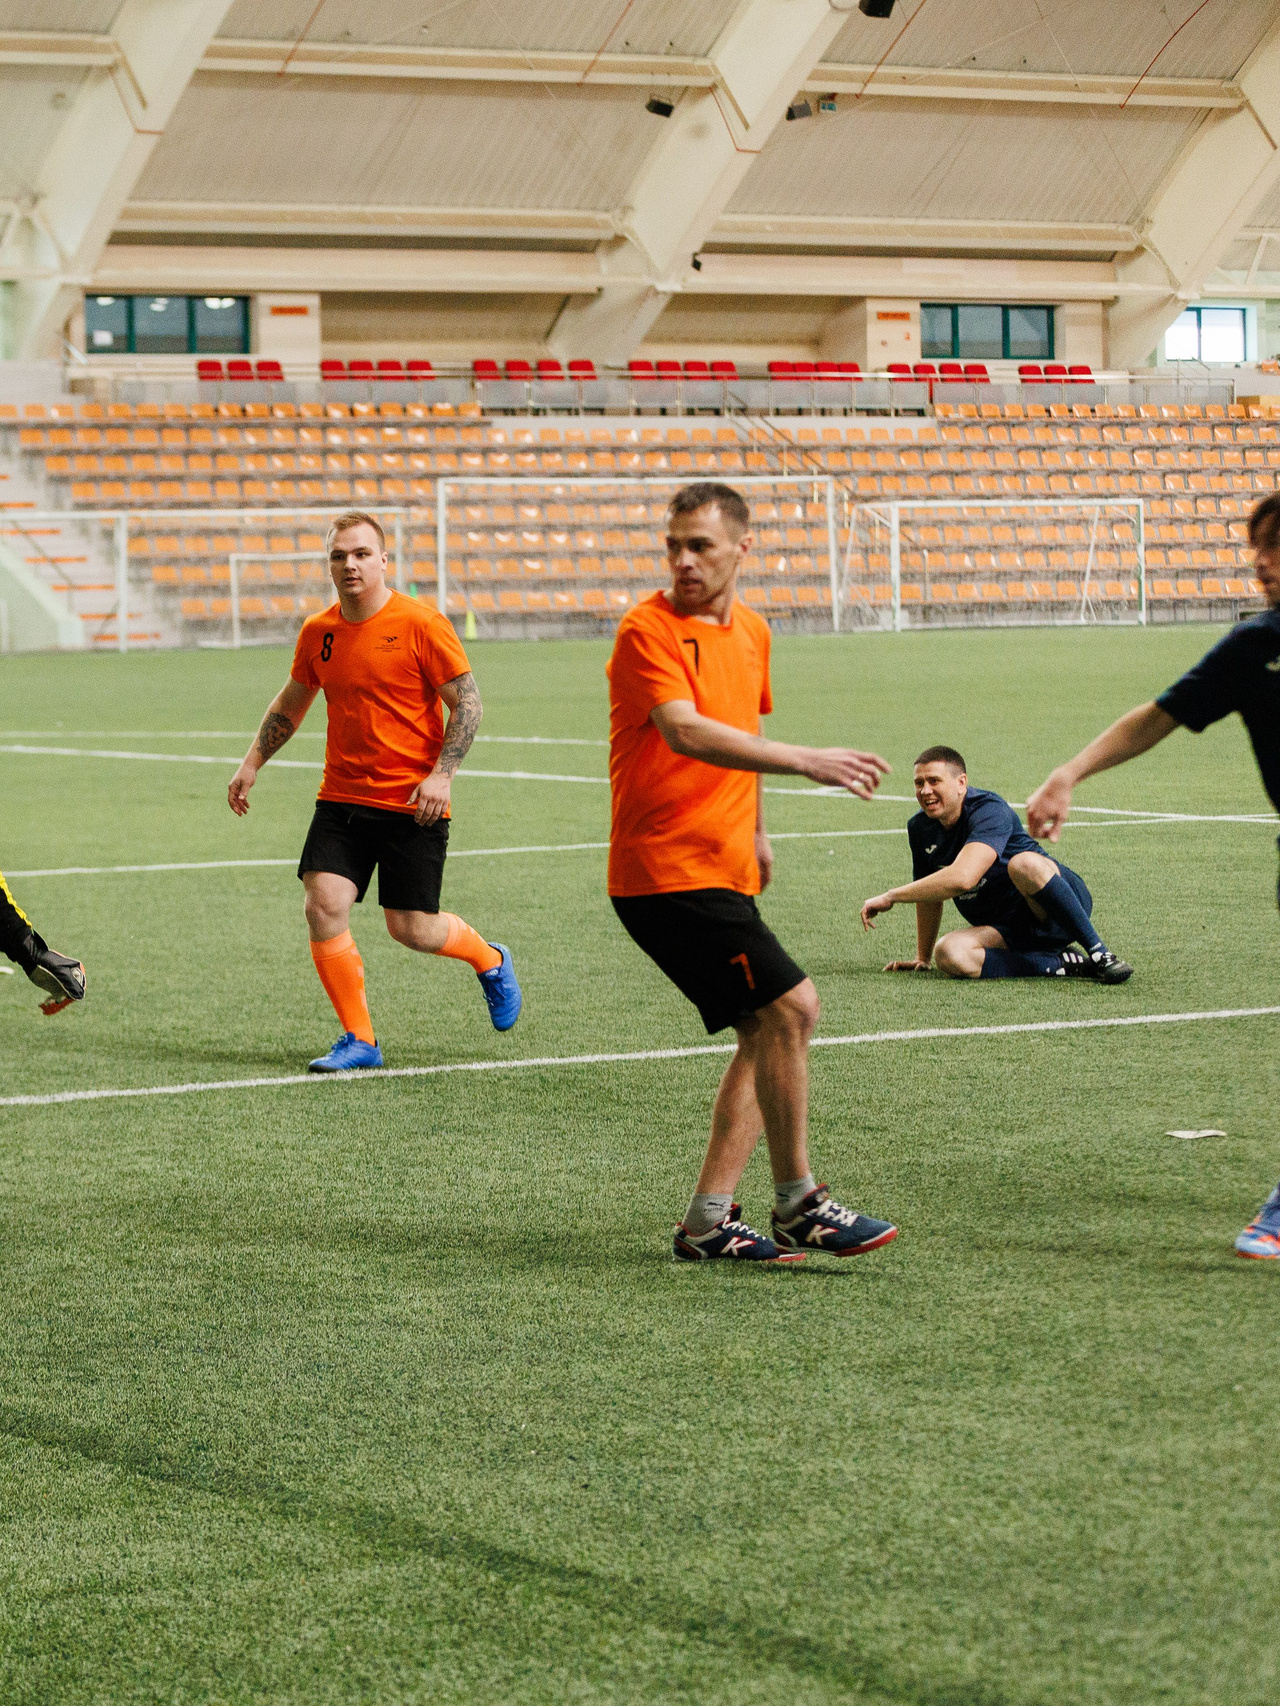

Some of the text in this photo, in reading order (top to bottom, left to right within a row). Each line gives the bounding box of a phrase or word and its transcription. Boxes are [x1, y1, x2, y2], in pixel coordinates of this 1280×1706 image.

[320, 632, 334, 662] 8
[683, 638, 699, 676] 7
[730, 953, 756, 990] 7
